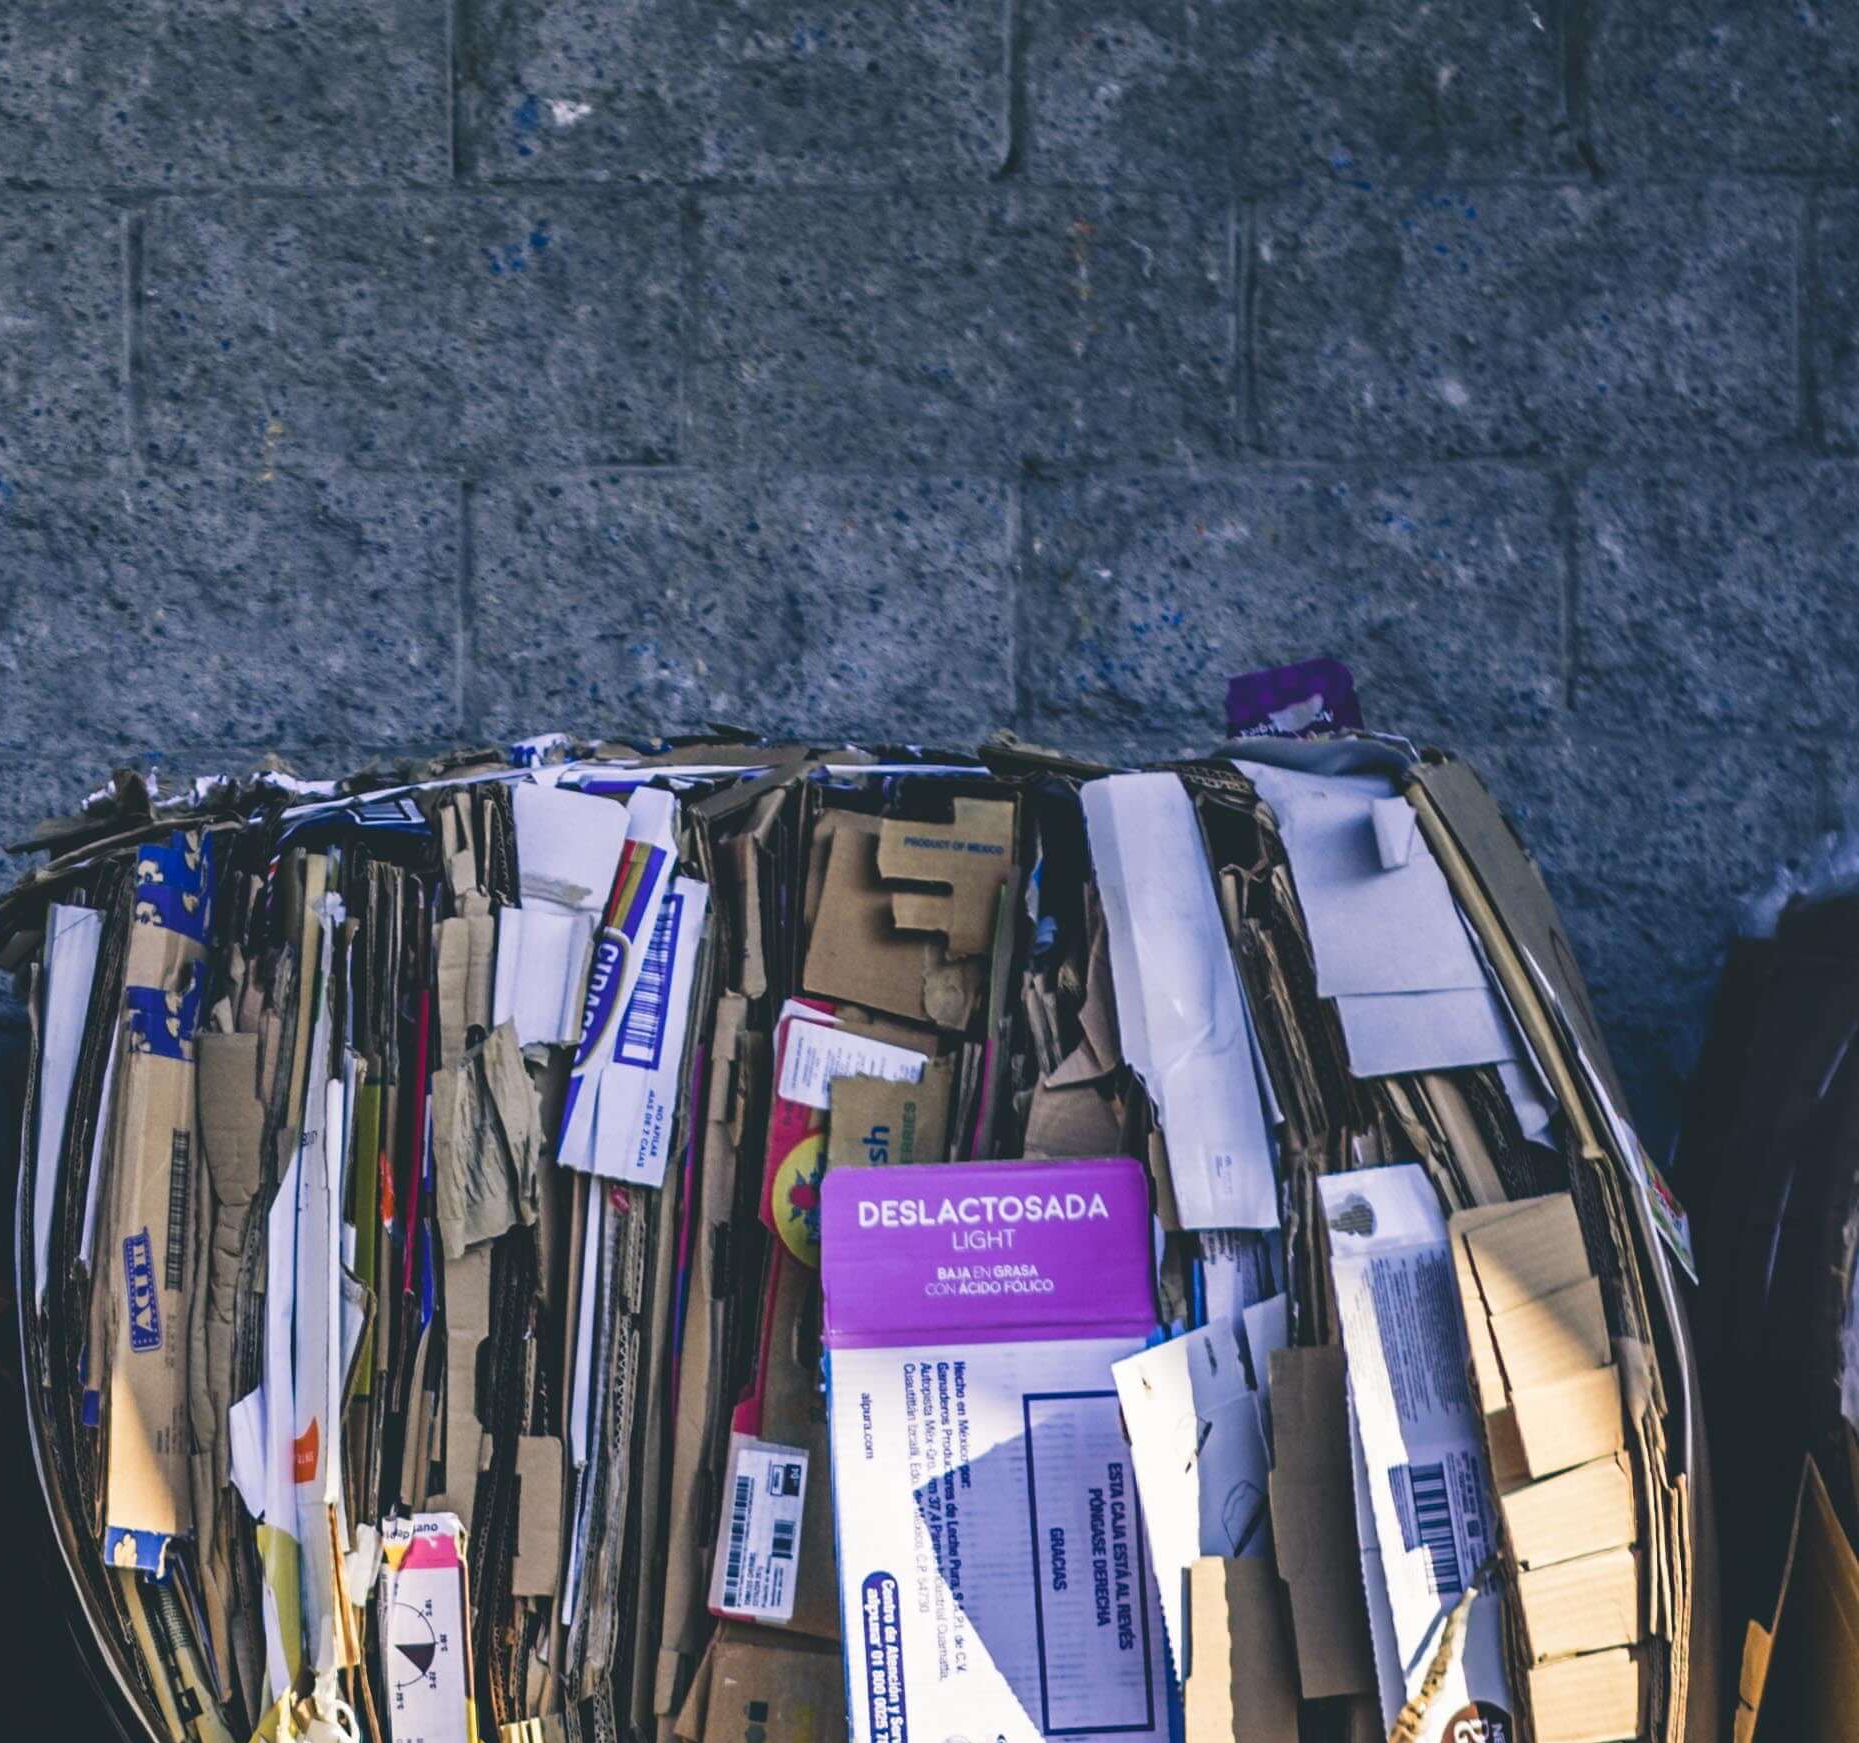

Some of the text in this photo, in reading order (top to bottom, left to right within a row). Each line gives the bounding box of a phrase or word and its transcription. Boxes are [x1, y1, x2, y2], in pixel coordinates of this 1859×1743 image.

[857, 1193, 1109, 1228] DESLACTOSADA
[952, 1228, 1017, 1252] LIGHT
[925, 1277, 1055, 1297] CON ÁCIDO FÓLICO
[936, 1264, 1039, 1281] BAJA EN GRASA
[920, 1362, 933, 1417] Autopista
[936, 1362, 951, 1426] Ganaderos
[953, 1361, 966, 1399] Hecho
[861, 1392, 874, 1460] alpura.com
[957, 1401, 967, 1416] en
[957, 1419, 969, 1462] México
[1107, 1461, 1124, 1500] ESTA
[945, 1502, 959, 1518] de
[1110, 1501, 1127, 1541] CAJA
[946, 1520, 960, 1557] Leche
[1088, 1487, 1111, 1628] PÓNGASE DERECHA
[1049, 1527, 1068, 1593] GRACIAS
[1115, 1577, 1131, 1599] AL
[1117, 1602, 1137, 1652] REVÉS
